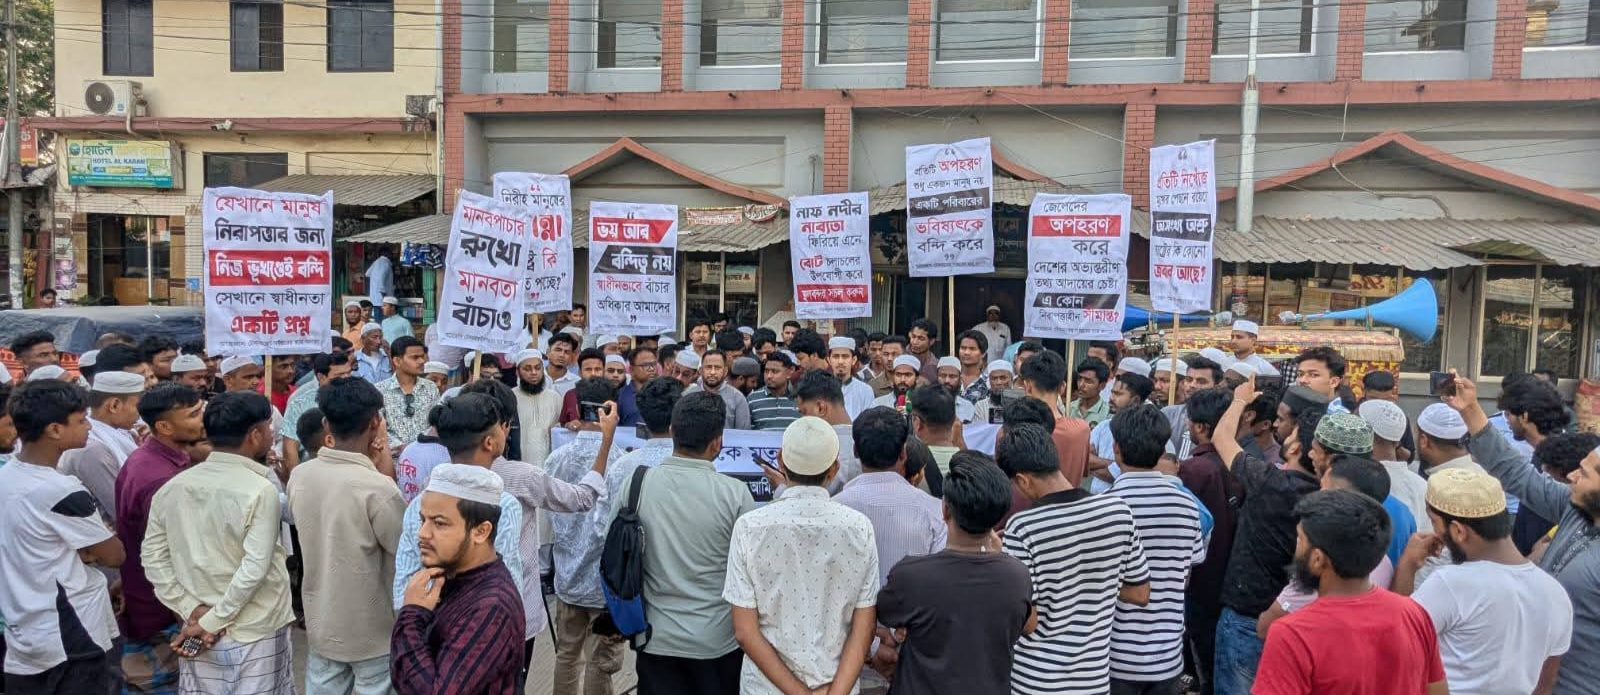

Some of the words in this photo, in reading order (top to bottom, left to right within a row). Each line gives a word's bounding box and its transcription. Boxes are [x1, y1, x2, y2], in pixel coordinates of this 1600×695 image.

[938, 157, 982, 172] অপহরণ
[913, 181, 926, 193] শুধু
[953, 178, 970, 189] মানুষ
[973, 176, 984, 185] নয়
[1157, 170, 1179, 188] প্রতিটি
[215, 195, 274, 214] যেখানে
[281, 198, 325, 218] মানুষ
[501, 188, 529, 207] নিরীহ
[530, 193, 566, 209] মানুষের
[915, 197, 940, 209] একটি
[942, 195, 983, 208] পরিবারের
[1044, 201, 1088, 213] জেলেদের
[796, 206, 823, 219] নাফ
[827, 199, 862, 217] নদীর
[462, 205, 526, 238] মানবপাচার
[597, 221, 619, 239] ভয়
[622, 223, 650, 240] আর
[801, 219, 845, 234] নাব্যতা
[1048, 217, 1111, 235] অপহরণ
[1155, 219, 1183, 233] অসংখ্য
[1185, 218, 1208, 233] অশ্রু
[215, 217, 289, 243] নিরাপত্তার
[294, 226, 326, 247] জন্য
[808, 234, 840, 248] ফিরিয়ে
[842, 234, 862, 246] এনে
[460, 230, 522, 268] রুখো
[917, 238, 945, 253] বন্দি
[952, 239, 984, 250] করে
[1072, 240, 1111, 256] করে
[1173, 242, 1182, 257] কি
[215, 252, 243, 277] নিজ
[247, 257, 294, 283] ভূখণ্ডেই
[297, 255, 324, 279] বন্দি
[541, 247, 558, 270] কি
[611, 247, 648, 274] বন্দিত্ব
[652, 254, 673, 271] নয়
[800, 255, 823, 270] বোট
[825, 256, 861, 267] চলাচলের
[1034, 261, 1067, 273] দেশের
[1071, 258, 1121, 274] অভ্যন্তরীণ
[809, 268, 843, 281] উপযোগী
[845, 270, 863, 280] করে
[1034, 279, 1053, 289] তথ্য
[1056, 279, 1094, 289] আদায়ের
[1097, 277, 1118, 290] চেষ্টা
[1176, 265, 1206, 284] আছে?
[458, 270, 519, 301] মানবতা
[597, 276, 643, 293] স্বাধীনভাবে
[645, 278, 670, 293] বাঁচার
[215, 292, 267, 306] সেখানে
[270, 287, 326, 306] স্বাধীনতা
[596, 295, 631, 313] অধিকার
[633, 301, 671, 313] আমাদের
[1041, 294, 1052, 305] এ
[1056, 295, 1084, 308] কোন
[231, 309, 279, 334] একটি
[284, 315, 311, 336] প্রশ্ন
[452, 296, 512, 331] বাঁচাও
[1083, 305, 1120, 322] সীমান্ত?
